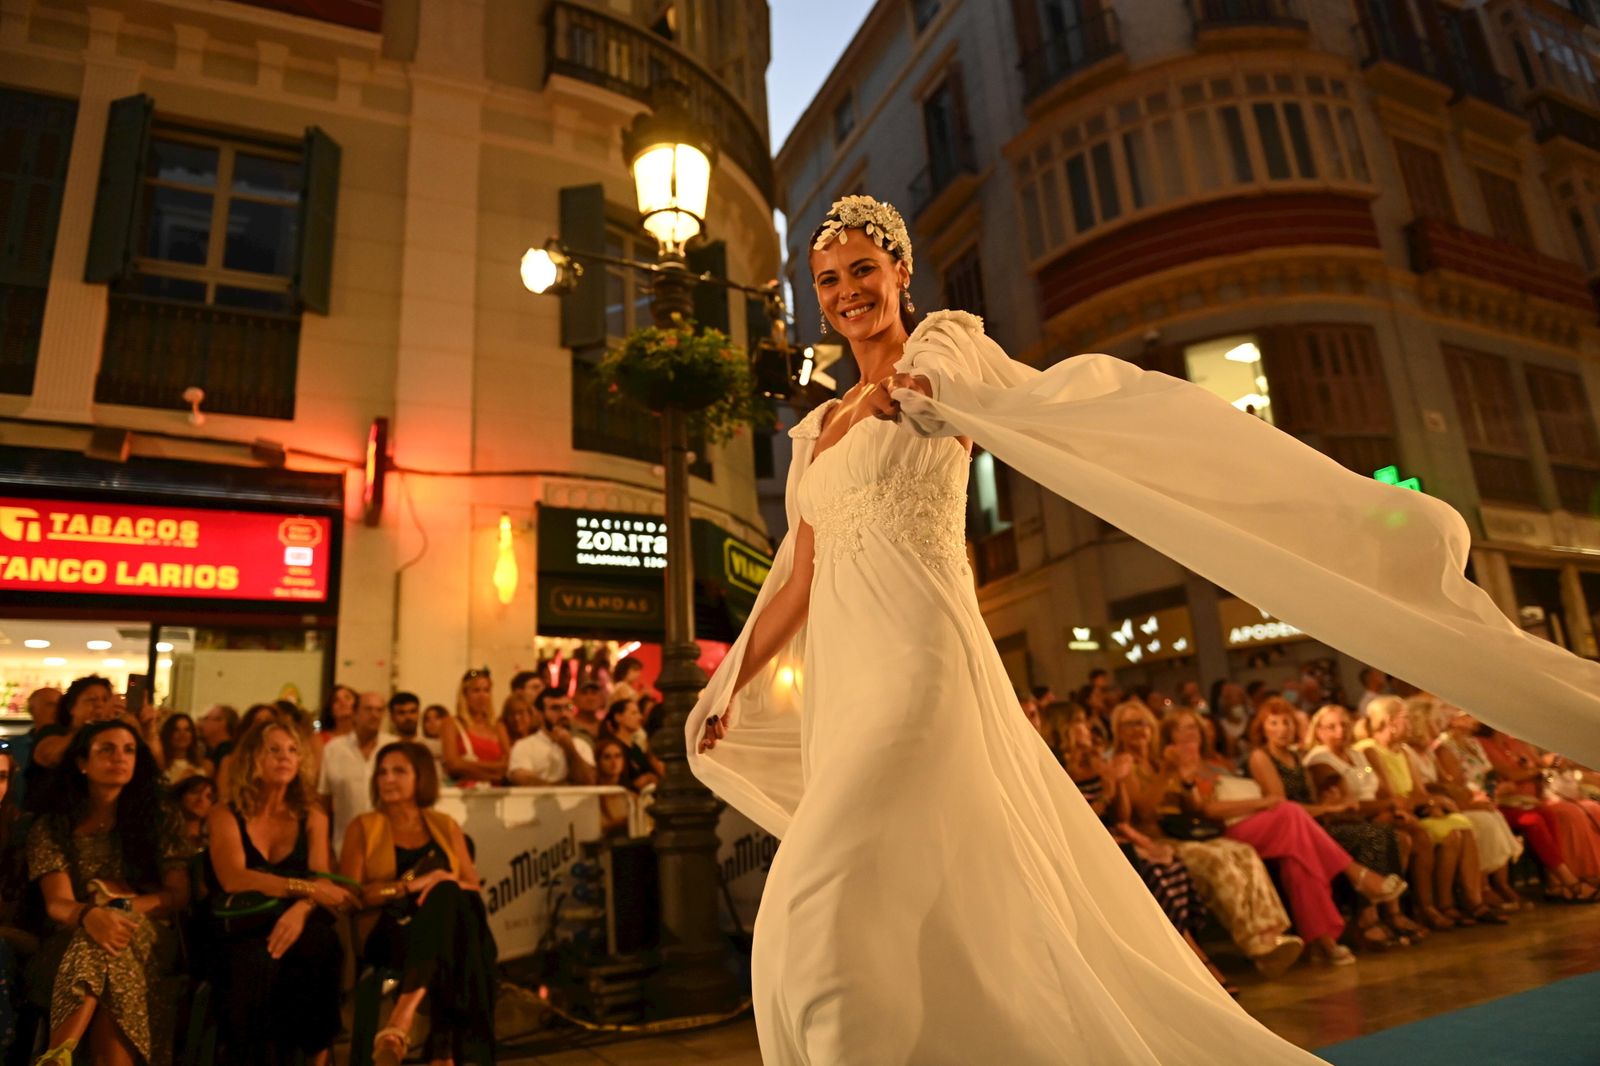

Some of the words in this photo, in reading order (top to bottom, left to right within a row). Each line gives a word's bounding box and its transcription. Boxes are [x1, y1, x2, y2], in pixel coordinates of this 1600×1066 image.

[49, 512, 199, 540] TABACOS
[115, 561, 239, 590] LARIOS
[561, 594, 649, 614] VIANDAS
